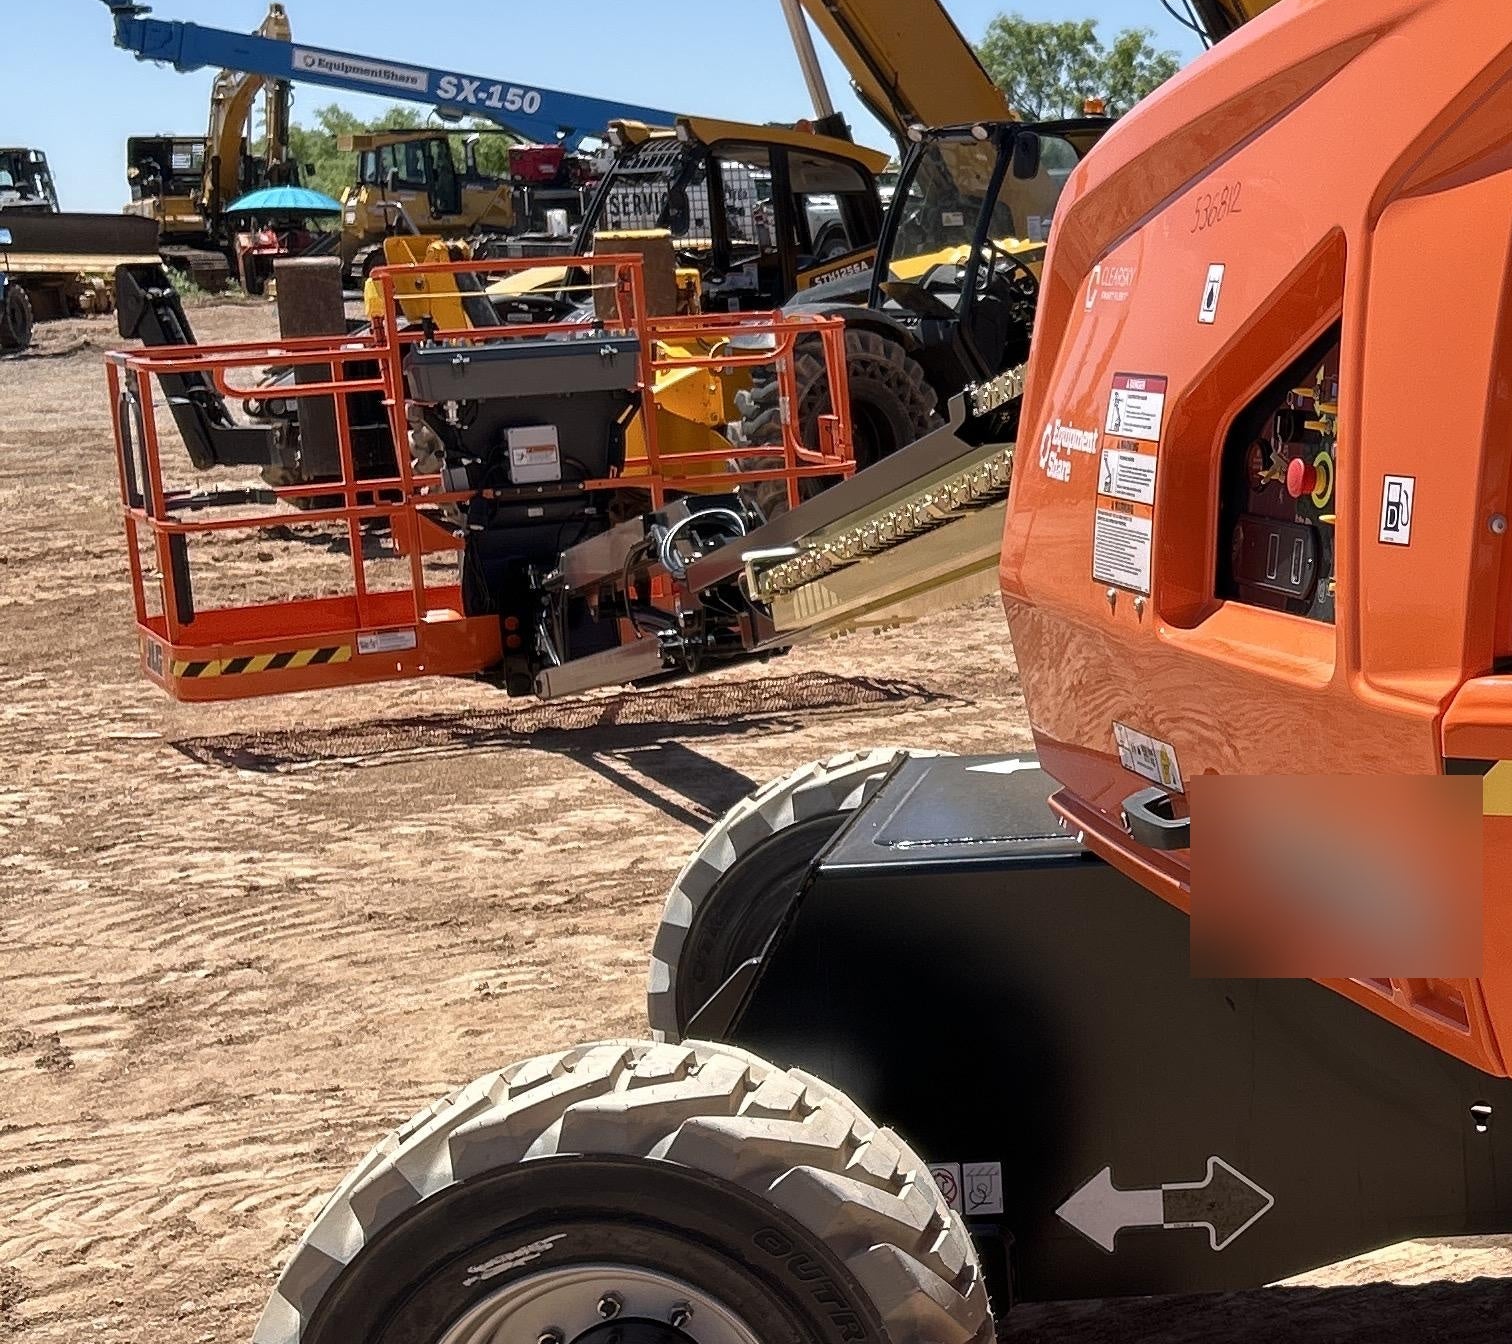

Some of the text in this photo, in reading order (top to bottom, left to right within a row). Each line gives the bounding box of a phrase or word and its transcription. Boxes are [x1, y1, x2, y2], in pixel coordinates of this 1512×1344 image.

[317, 57, 418, 86] EquipmentShare
[436, 75, 542, 114] SX-150
[1052, 418, 1098, 455] Equipment
[1046, 450, 1071, 483] Share
